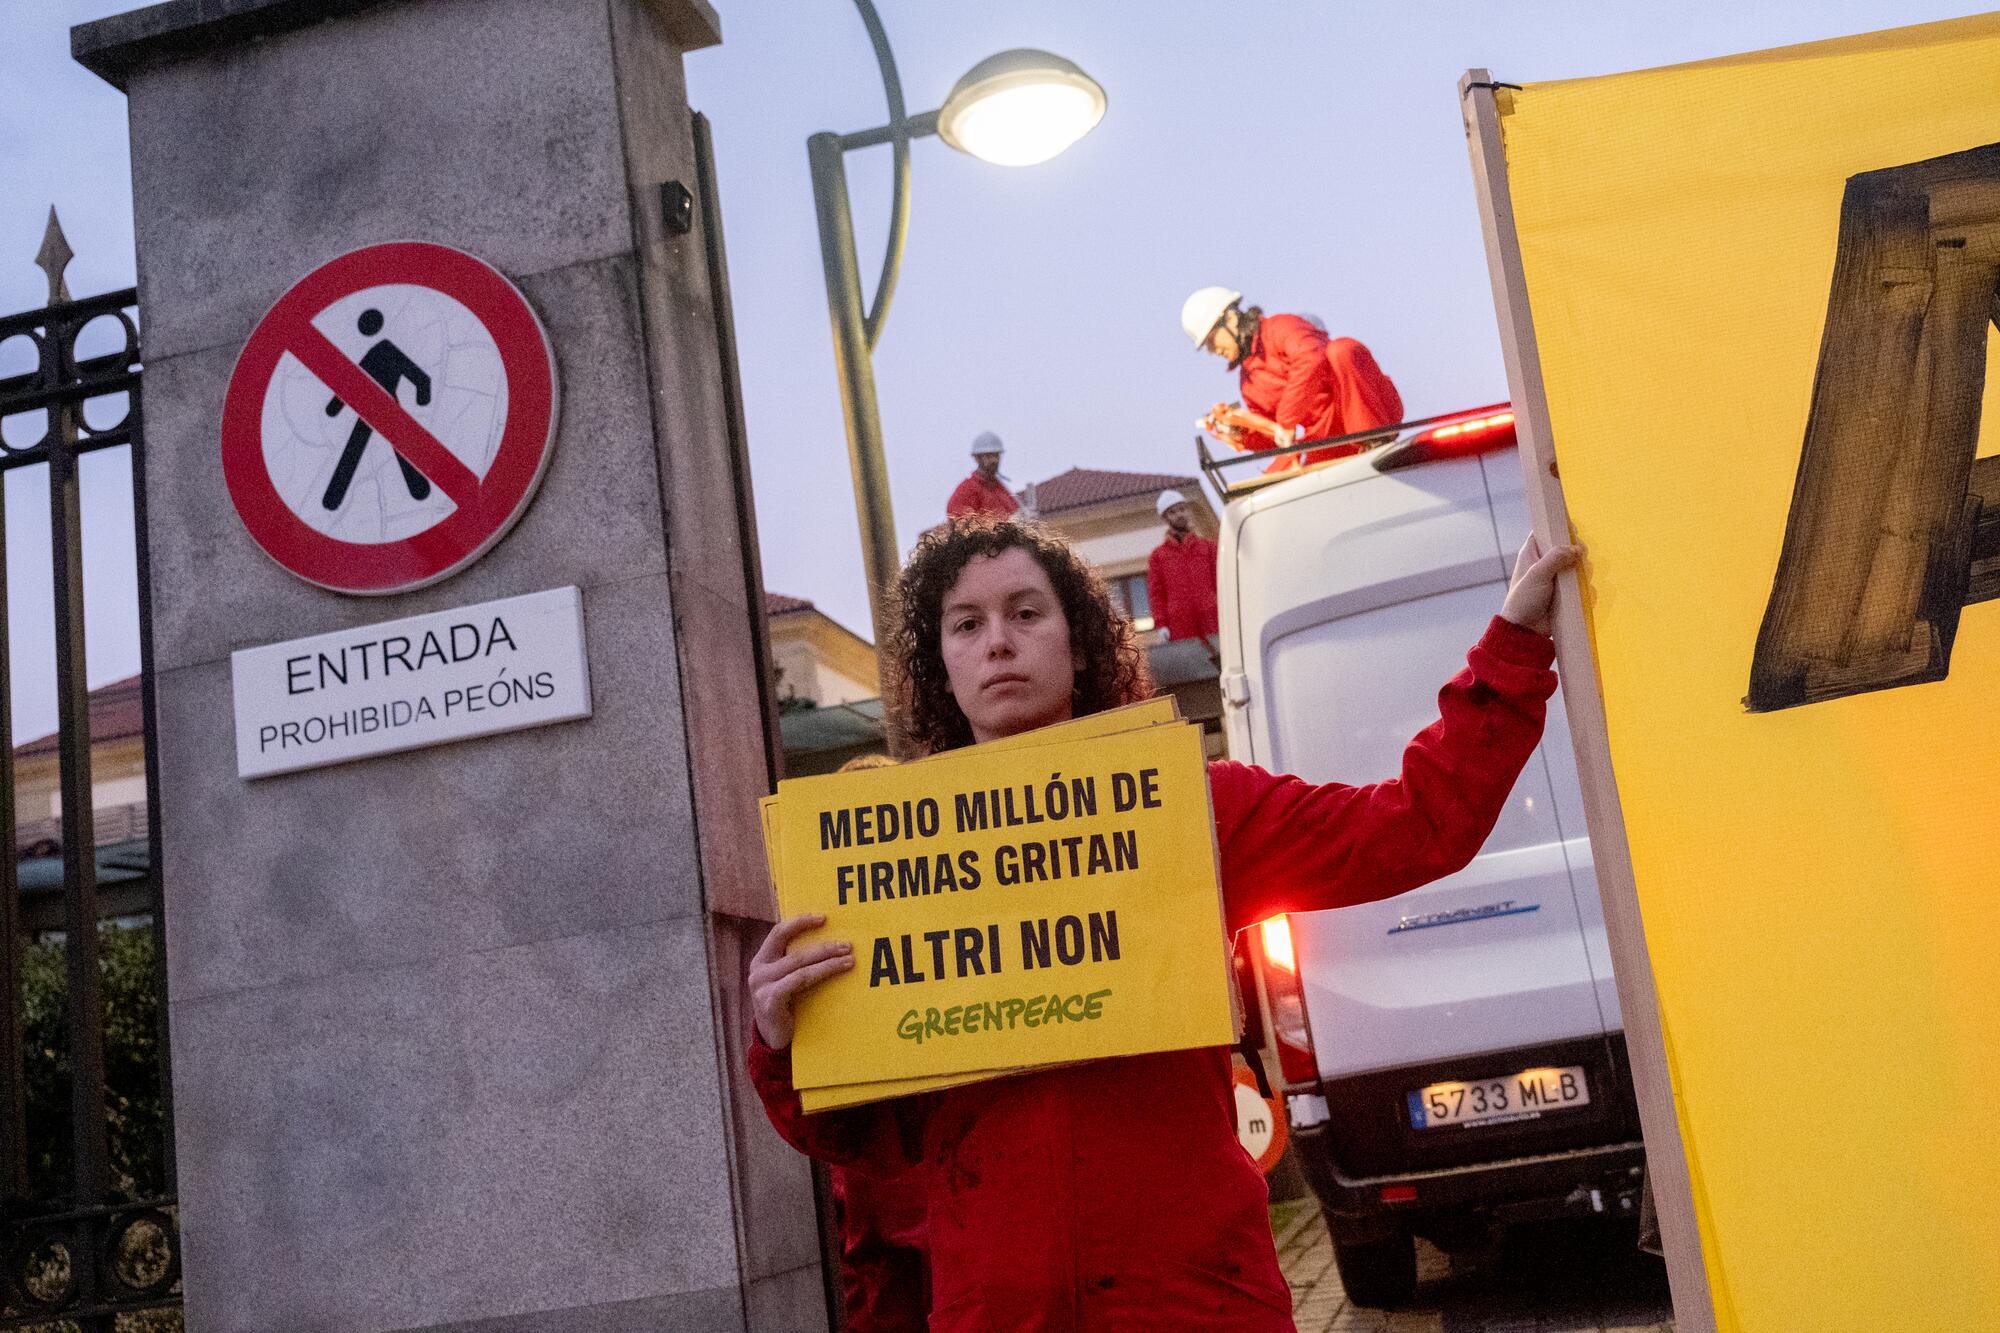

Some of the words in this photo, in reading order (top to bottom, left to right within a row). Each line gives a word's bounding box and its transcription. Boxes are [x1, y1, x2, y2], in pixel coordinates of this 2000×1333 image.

[286, 617, 517, 695] ENTRADA
[260, 697, 436, 753] PROHIBIDA
[444, 668, 555, 717] PEÓNS
[819, 797, 940, 850] MEDIO
[954, 772, 1098, 833] MILLÓN
[1111, 768, 1162, 814] DE
[836, 849, 982, 905] FIRMAS
[995, 830, 1139, 885] GRITAN
[869, 924, 1001, 988] ALTRI
[1020, 910, 1121, 970] NON
[896, 989, 1112, 1044] GREENPEACE
[1430, 1082, 1509, 1119] 5733
[1519, 1073, 1579, 1107] MLB
